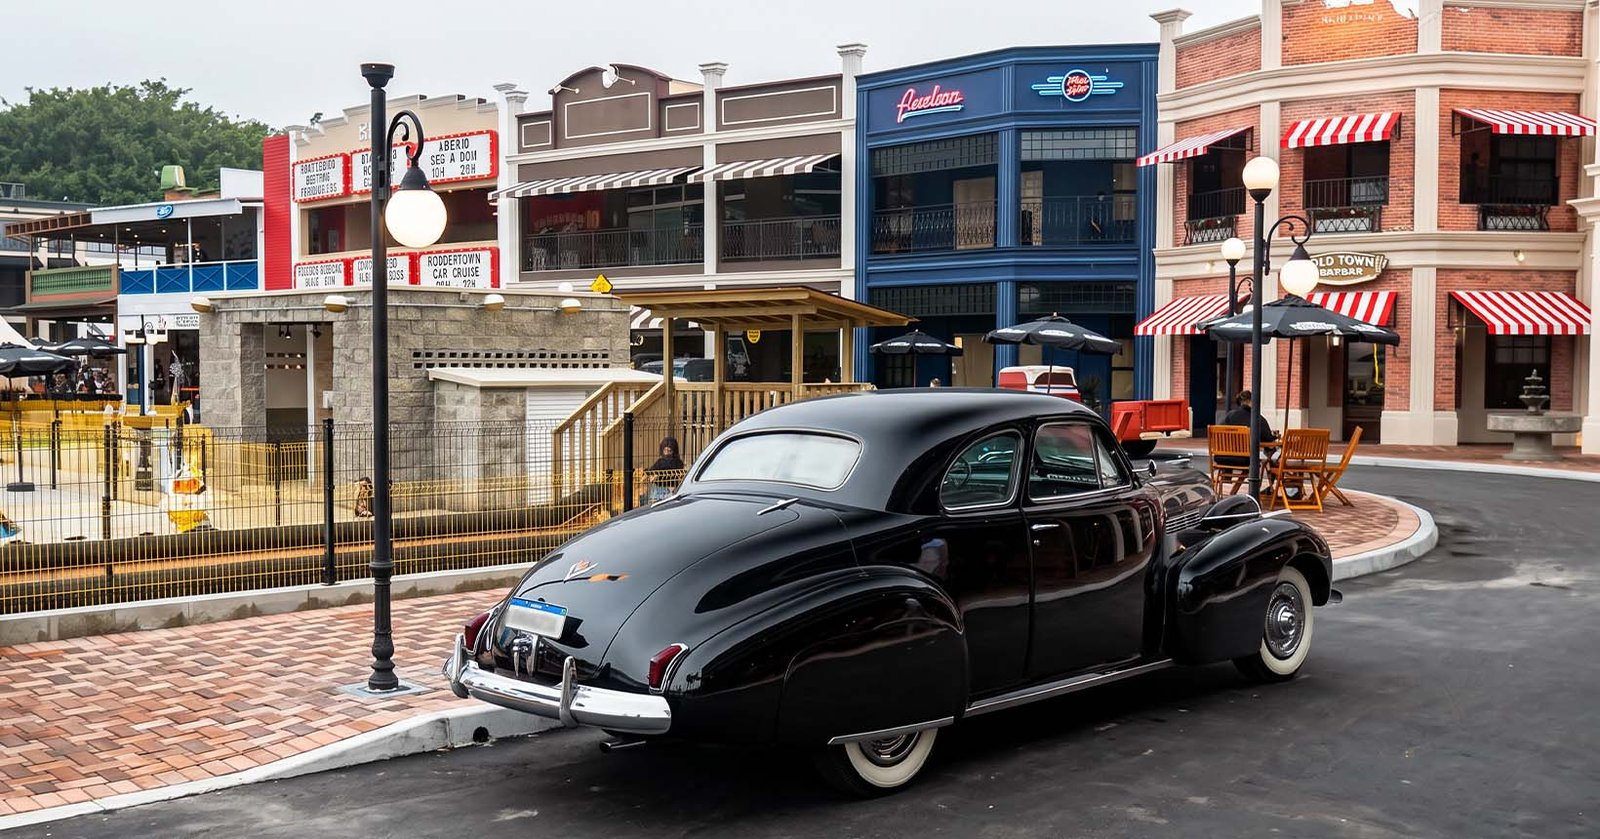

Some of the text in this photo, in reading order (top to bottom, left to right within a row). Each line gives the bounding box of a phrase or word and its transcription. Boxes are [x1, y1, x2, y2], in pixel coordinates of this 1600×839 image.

[430, 154, 445, 166] SEG
[449, 153, 455, 163] A
[432, 167, 445, 178] 10H
[427, 253, 481, 267] RODDERTOWN
[1338, 255, 1374, 267] TOWN
[432, 266, 480, 279] CAR CRUISE
